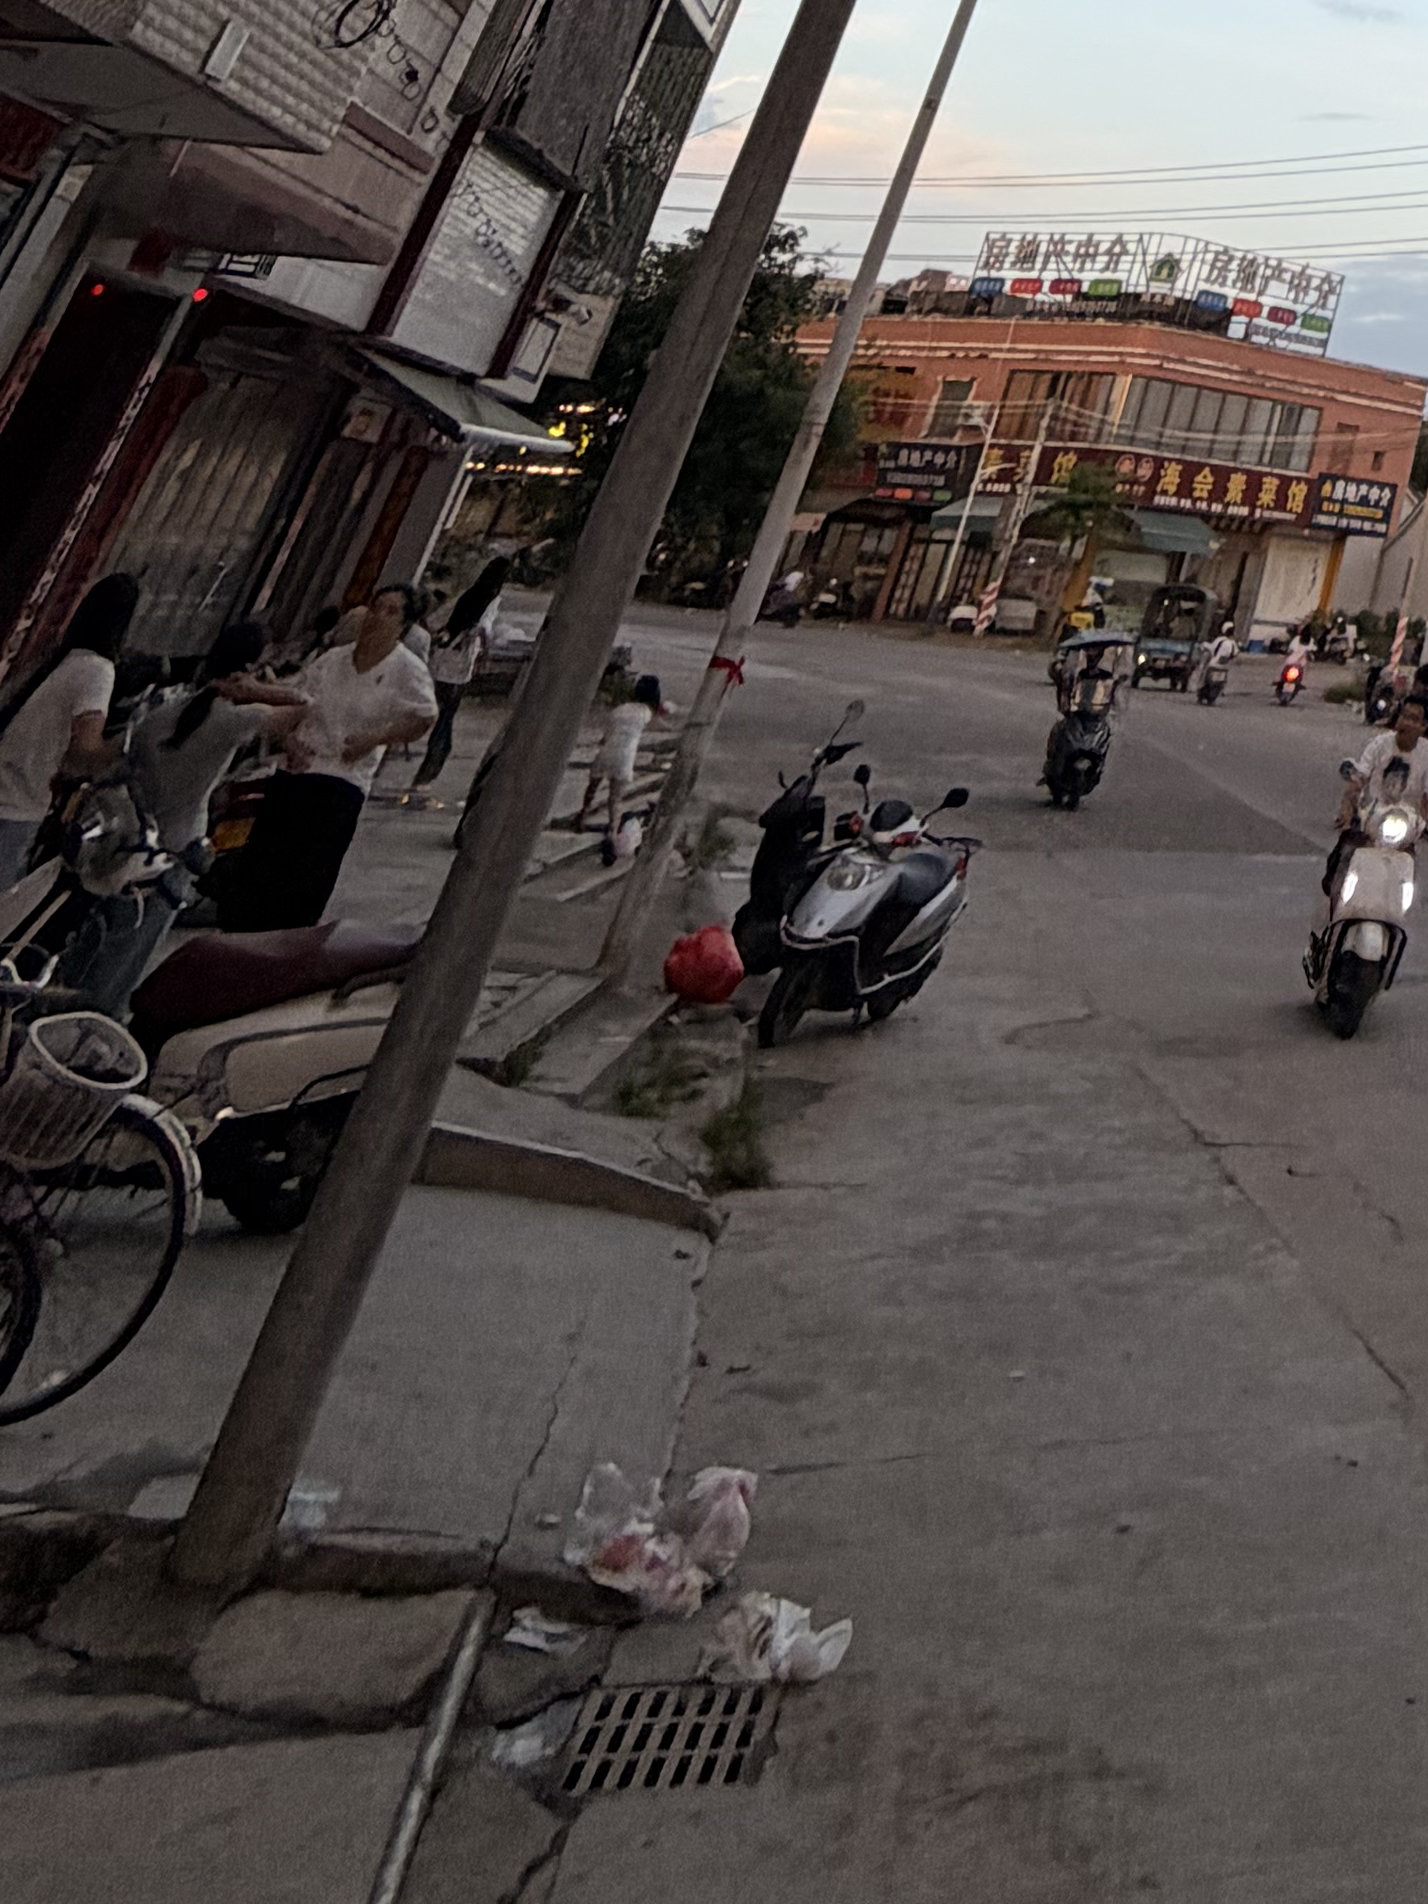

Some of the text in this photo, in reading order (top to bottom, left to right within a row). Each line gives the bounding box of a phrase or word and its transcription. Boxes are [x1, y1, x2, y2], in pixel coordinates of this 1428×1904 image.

[1156, 461, 1308, 514] 海会素菜馆
[1332, 479, 1391, 507] 房地产中介
